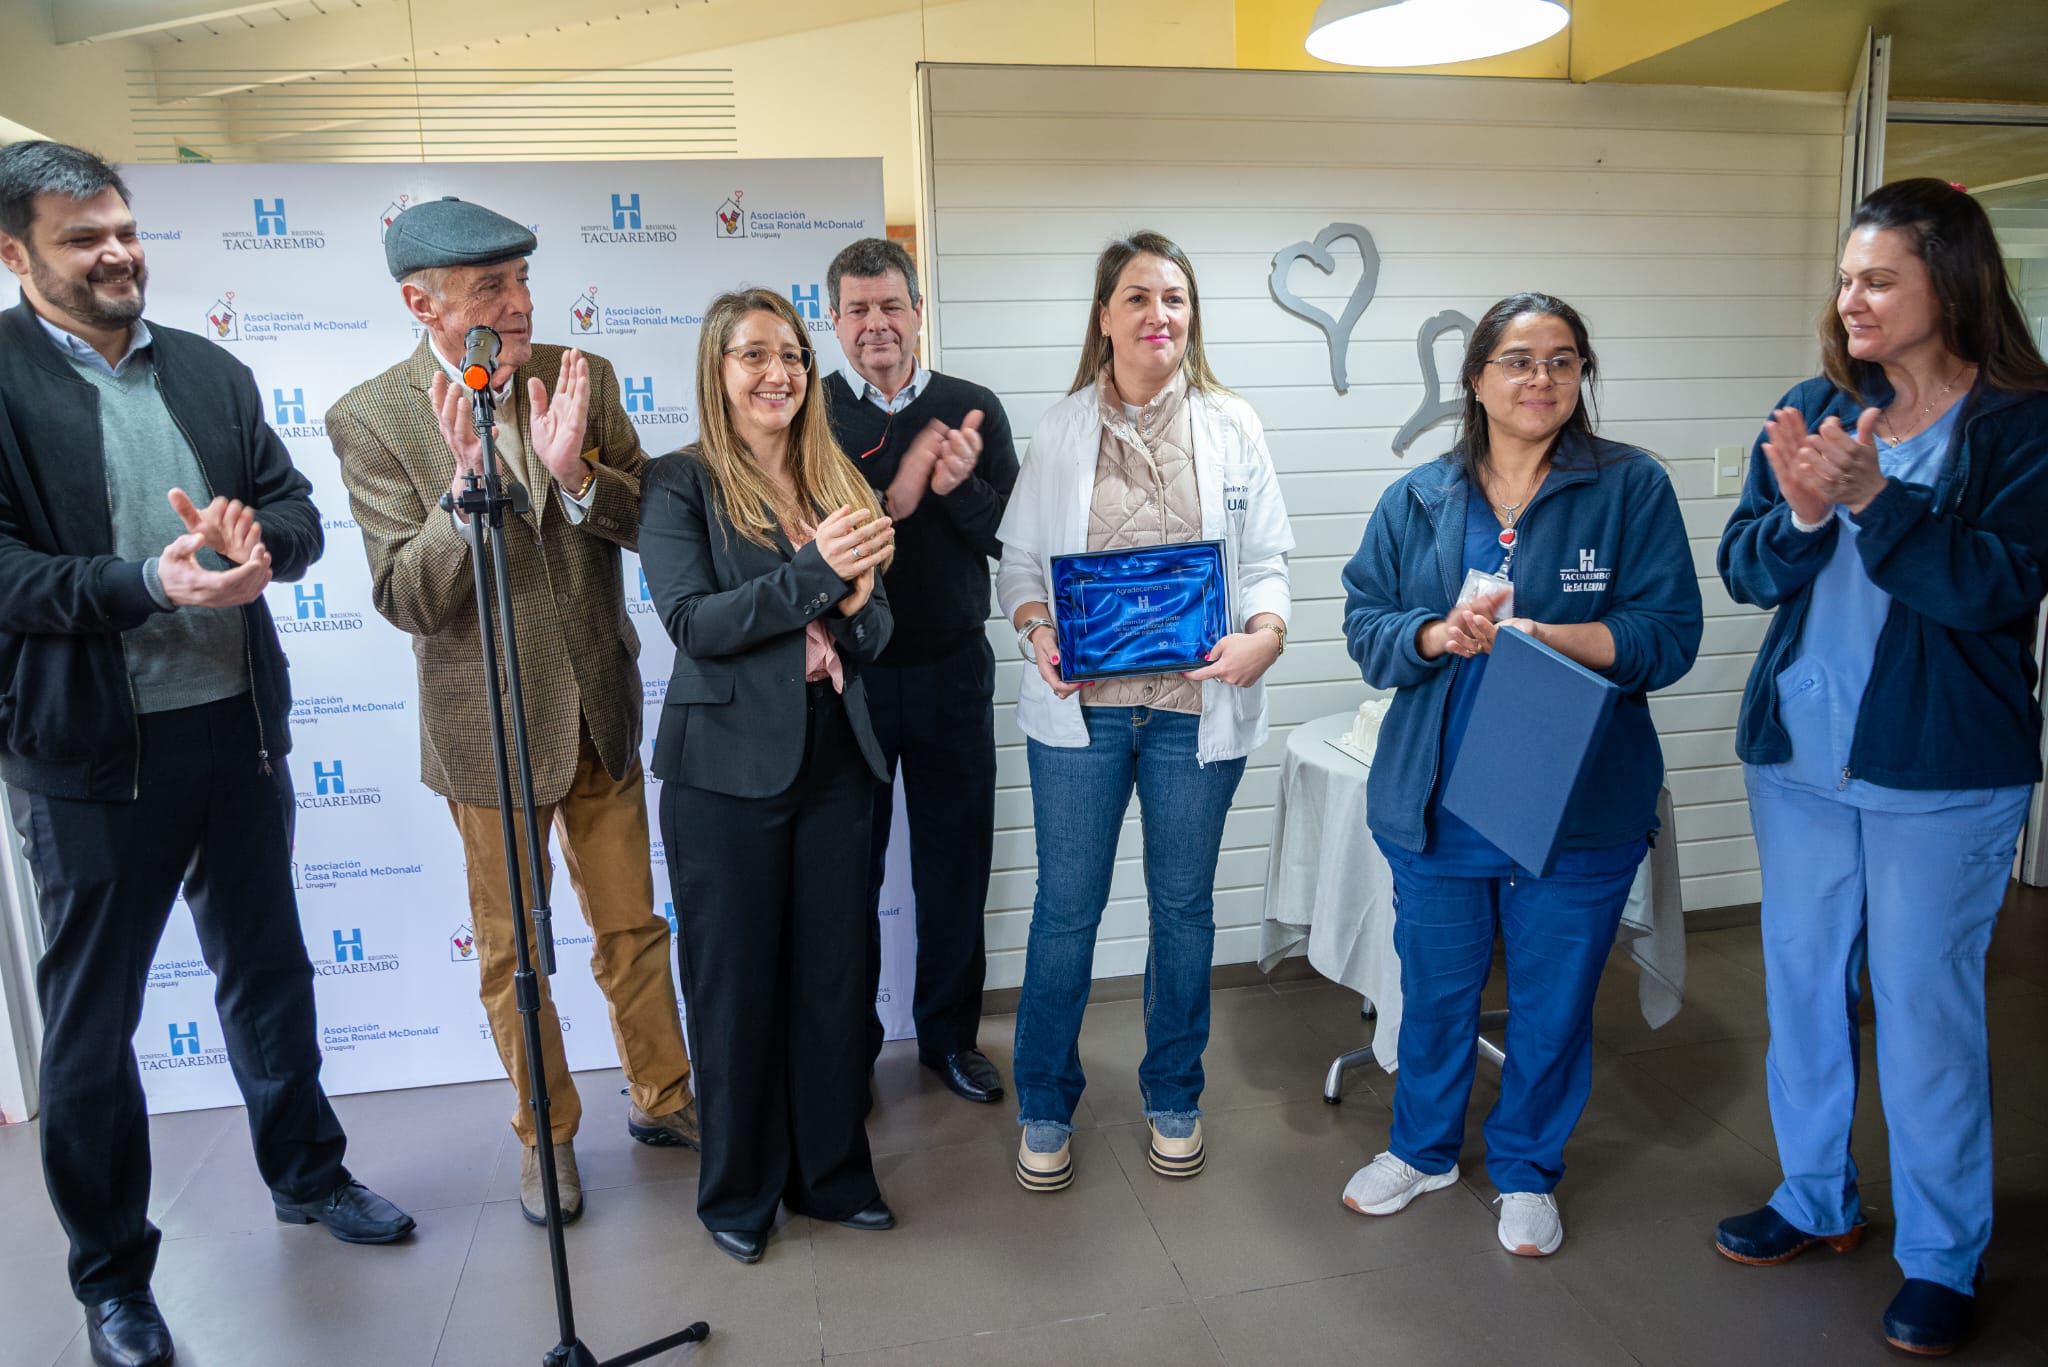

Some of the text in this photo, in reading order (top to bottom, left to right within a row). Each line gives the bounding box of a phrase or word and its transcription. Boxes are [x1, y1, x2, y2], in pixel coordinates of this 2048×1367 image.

[750, 211, 805, 220] Asociación
[751, 220, 863, 230] Casa Ronald McDonald
[135, 231, 180, 240] cDonald
[581, 231, 677, 243] TACUAREMBO
[223, 238, 325, 250] TACUAREMBO
[605, 306, 662, 315] Asociación
[244, 312, 304, 321] Asociación
[605, 315, 705, 325] Casa Ronald McDon
[244, 320, 367, 332] Casa Ronald McDonald
[245, 334, 277, 342] Uruguay
[632, 413, 689, 424] AREMBO
[276, 619, 363, 633] ACUAREMBO
[292, 696, 343, 706] sociación
[290, 701, 404, 716] asa Ronald McDonald
[296, 794, 381, 808] ACUAREMBO
[304, 861, 361, 871] Asociación
[305, 864, 421, 881] Casa Ronald McDonald
[556, 936, 593, 945] cDonal
[152, 960, 204, 970] sociación
[314, 960, 399, 976] ACUAREMBO
[324, 1024, 379, 1035] Asociación
[324, 1026, 439, 1044] Casa Ronald McDonald
[140, 1054, 228, 1070] TACUAREMB
